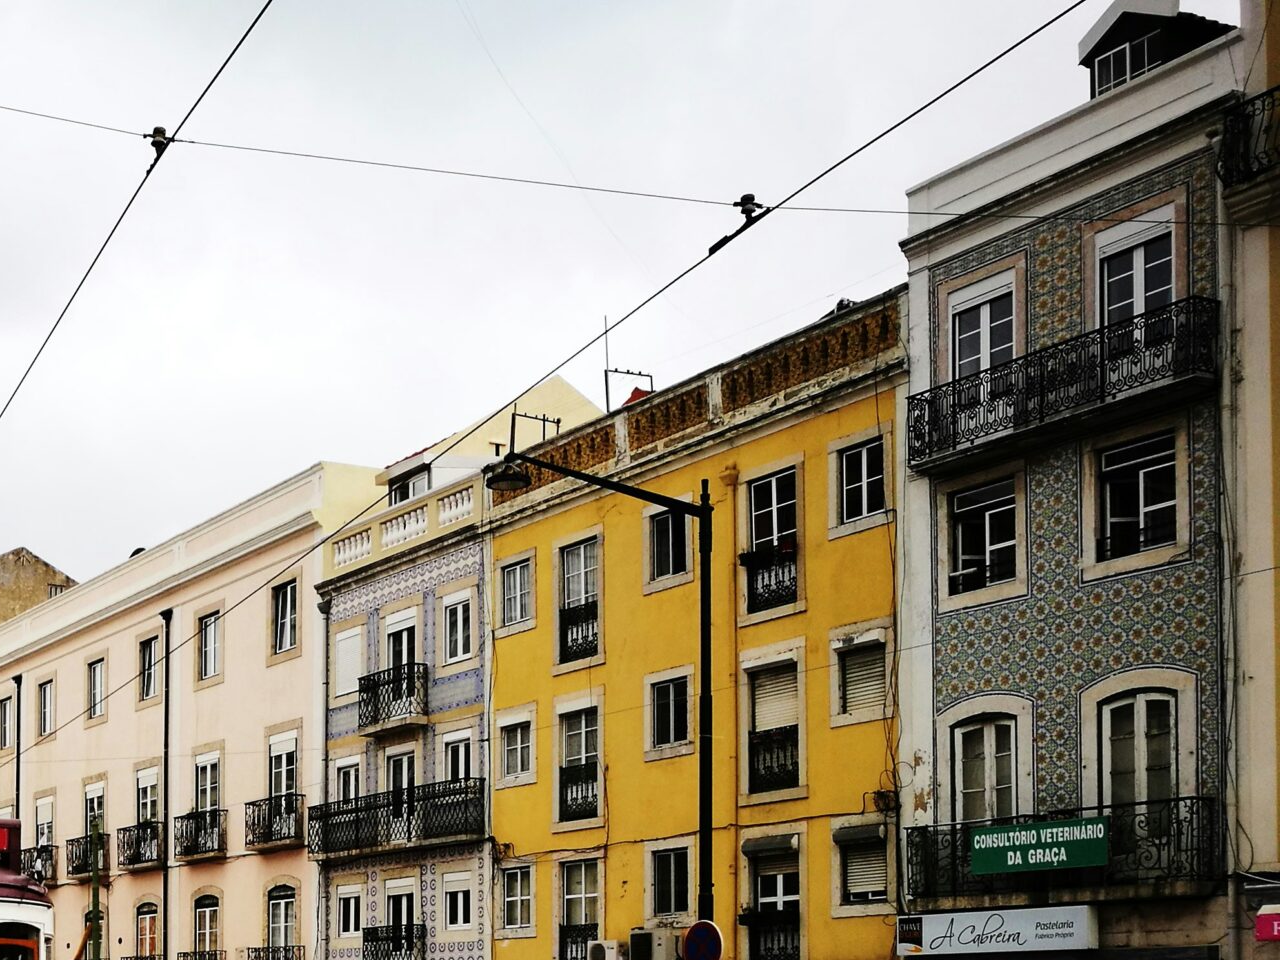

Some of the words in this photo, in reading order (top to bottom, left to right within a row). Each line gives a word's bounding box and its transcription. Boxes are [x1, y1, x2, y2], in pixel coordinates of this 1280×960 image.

[974, 828, 1037, 850] CONSULTÓRIO
[1040, 821, 1105, 844] VETERINÁRIO
[1007, 850, 1023, 866] DA
[1027, 846, 1067, 866] GRAÇA
[929, 917, 954, 950] A
[958, 913, 1027, 946] Cabreira
[1034, 919, 1075, 931] Pastelaria
